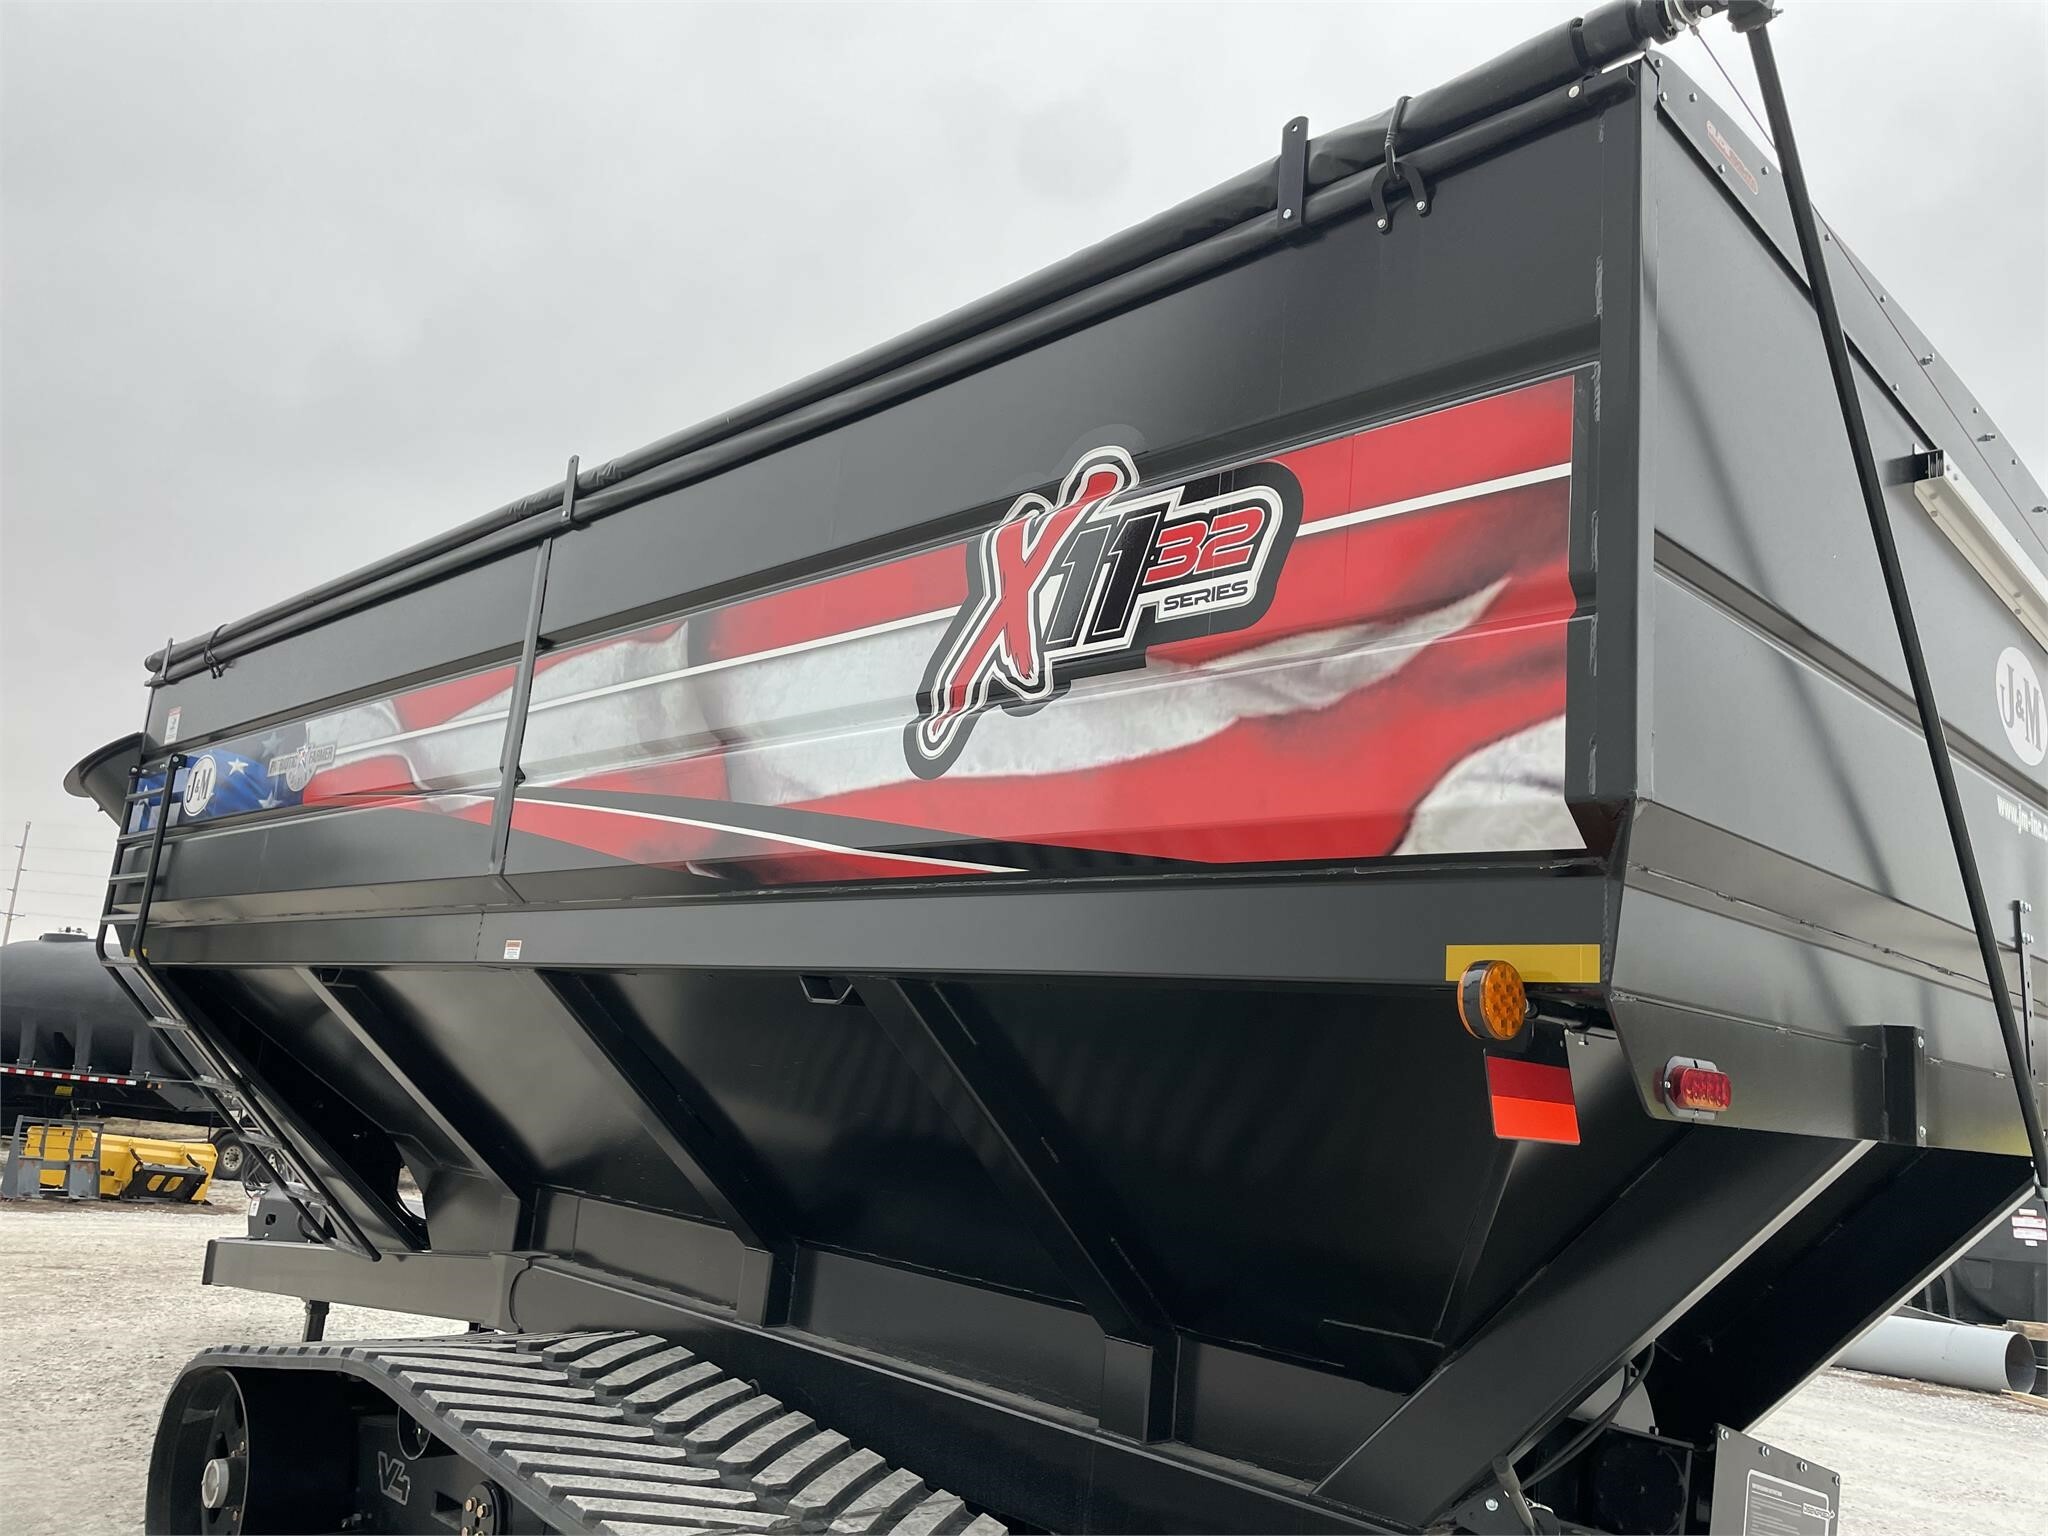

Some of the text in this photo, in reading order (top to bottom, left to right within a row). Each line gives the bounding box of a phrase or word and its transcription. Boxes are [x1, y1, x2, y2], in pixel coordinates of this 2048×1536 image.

[1163, 579, 1249, 611] SERIES
[1999, 664, 2042, 752] J&M
[186, 767, 212, 803] J&M
